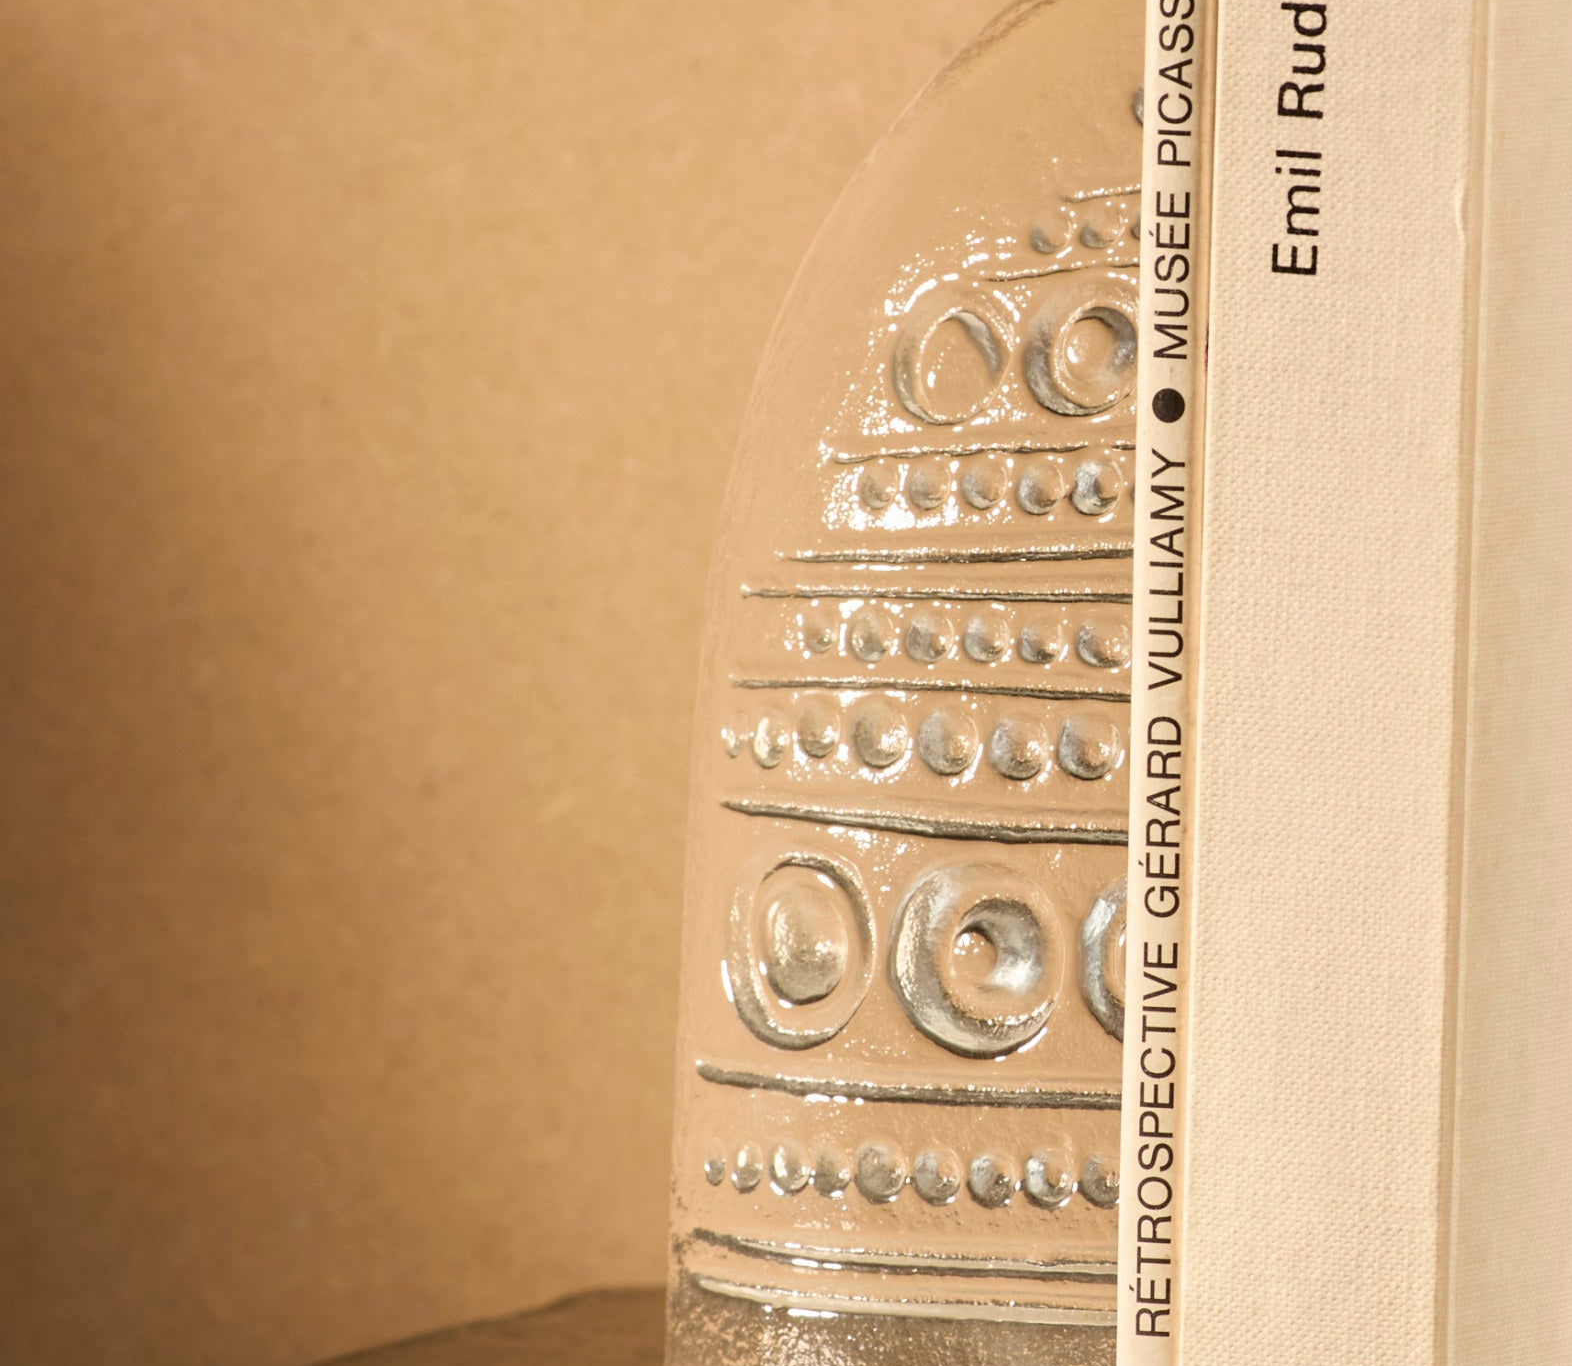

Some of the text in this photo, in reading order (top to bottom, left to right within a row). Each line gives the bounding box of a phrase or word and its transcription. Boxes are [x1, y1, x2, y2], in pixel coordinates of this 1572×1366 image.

[1148, 190, 1191, 360] MUSÉE
[1271, 149, 1322, 276] Emil
[1148, 448, 1186, 691] VULLIAMY
[1138, 716, 1182, 918] GÉRARD
[1129, 941, 1179, 1338] RÉTROSPECTIVE
